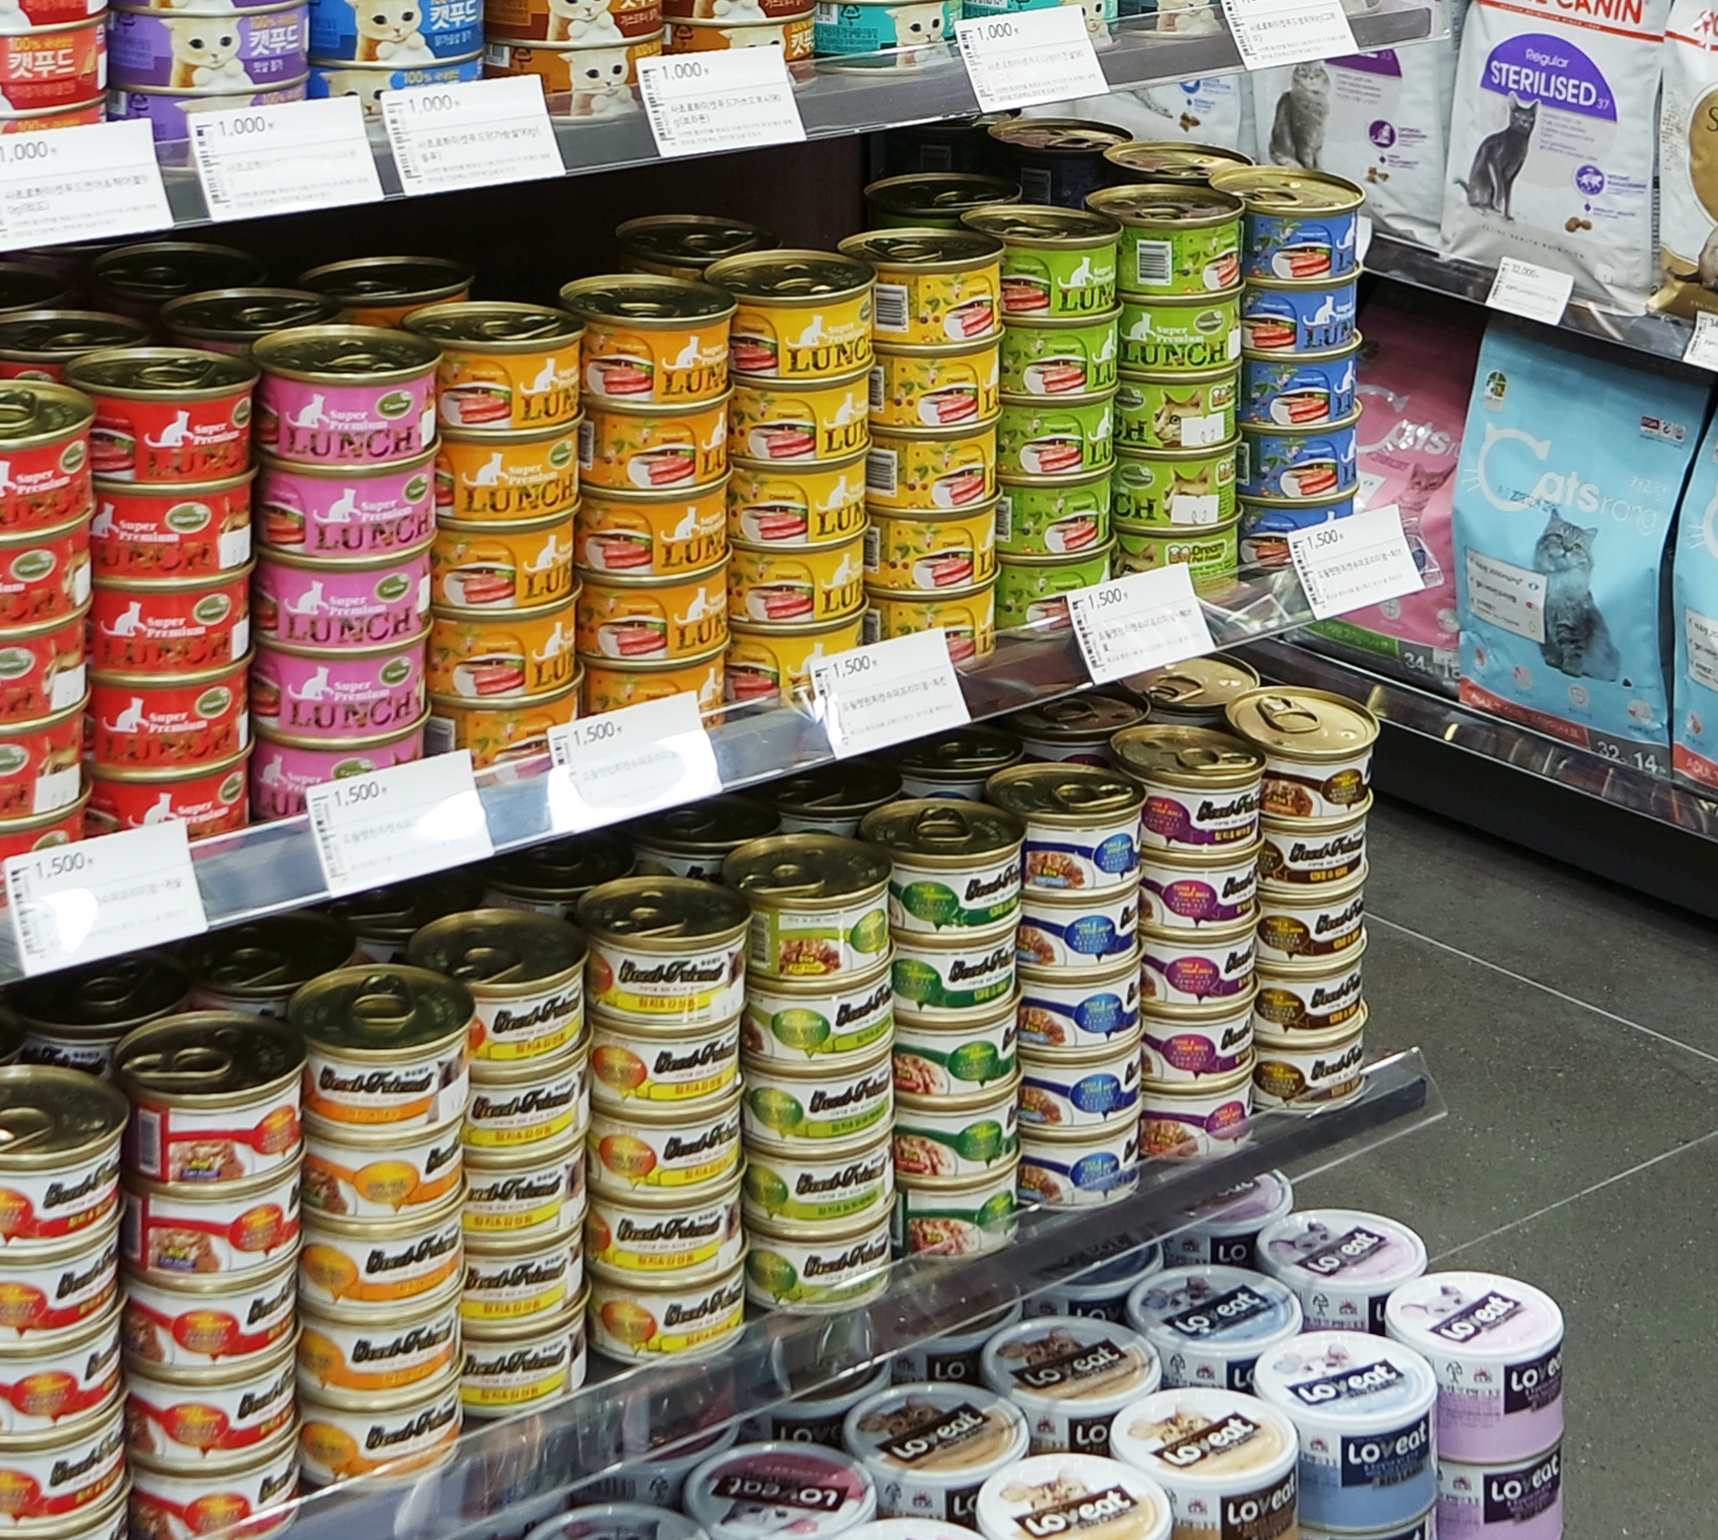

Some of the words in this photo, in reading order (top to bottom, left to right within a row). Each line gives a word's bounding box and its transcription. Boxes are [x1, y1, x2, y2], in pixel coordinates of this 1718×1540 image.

[977, 22, 1013, 40] 1,000
[8, 47, 75, 80] 캣푸드
[1526, 49, 1570, 69] Regular
[1490, 60, 1596, 106] STERILISED
[1597, 100, 1610, 110] 37
[1123, 341, 1227, 368] LUNCH
[329, 409, 368, 422] Super
[285, 430, 414, 459] LUNCH
[463, 474, 575, 513] LUNCH
[314, 515, 431, 552] LUNCH
[1305, 529, 1338, 547] 1,500
[1193, 542, 1224, 555] Dream
[1087, 588, 1122, 610] 1,500
[287, 612, 412, 644] LUNCH
[290, 699, 413, 731] LUNCH
